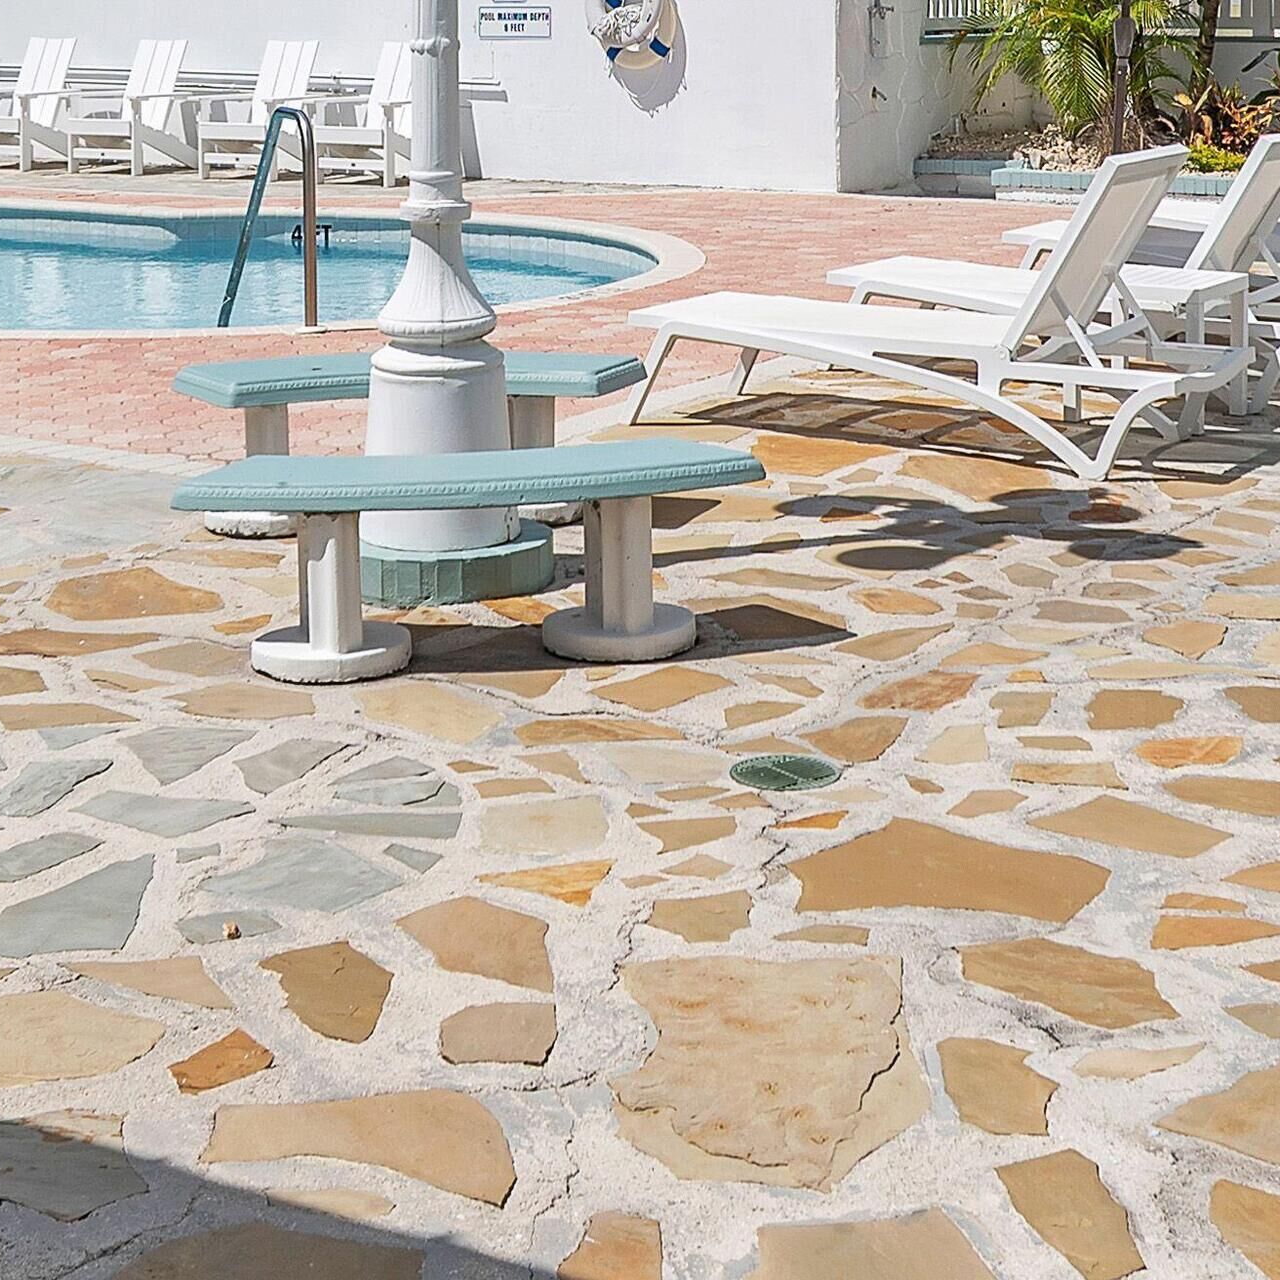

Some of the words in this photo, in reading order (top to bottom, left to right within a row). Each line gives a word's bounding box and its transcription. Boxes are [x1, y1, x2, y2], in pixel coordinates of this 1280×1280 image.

[480, 12, 495, 21] POOL
[497, 12, 528, 21] MAXIMUM
[529, 12, 549, 21] DEPTH
[510, 23, 525, 32] FEET
[291, 224, 303, 241] 4
